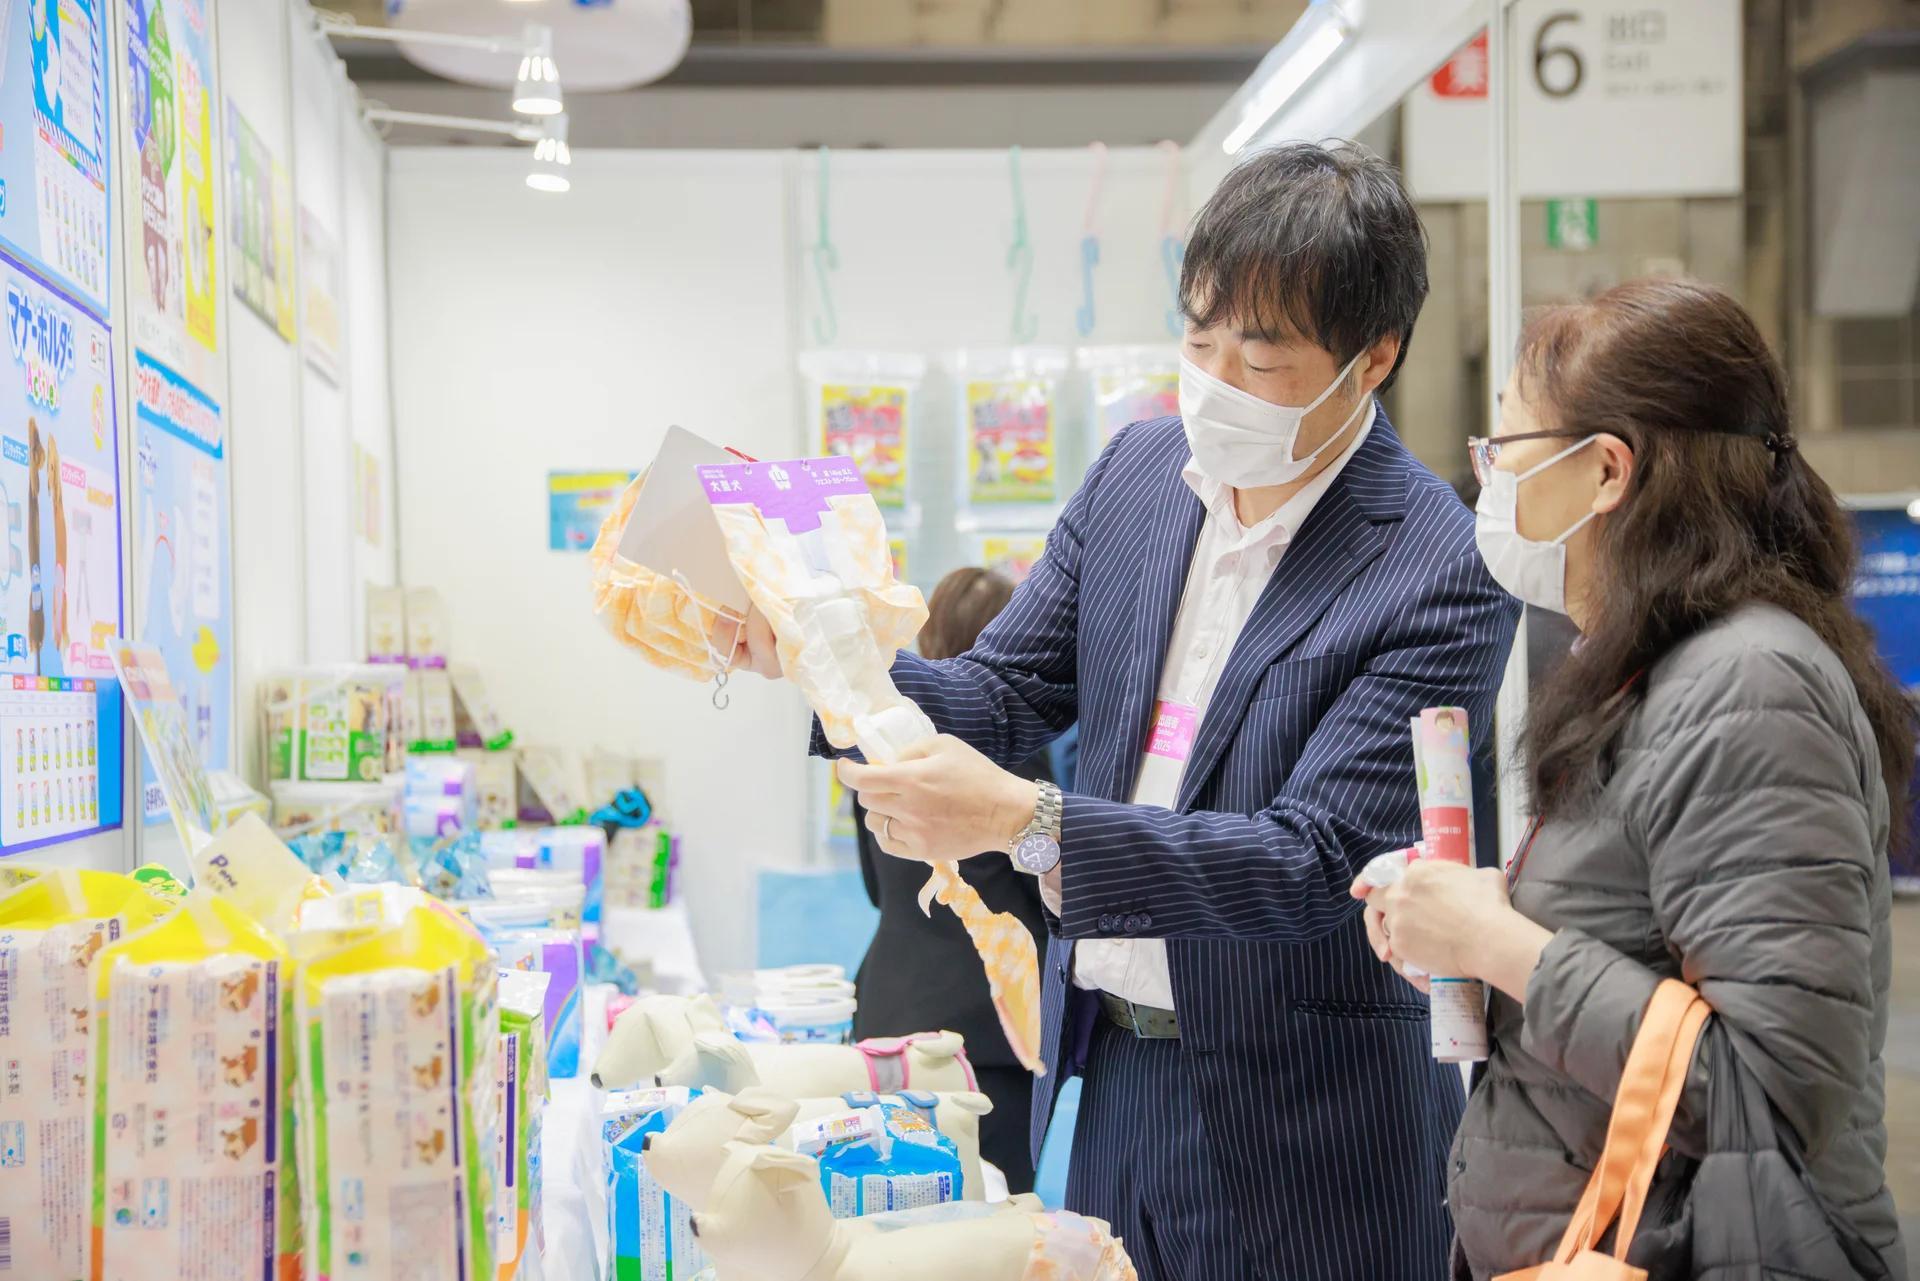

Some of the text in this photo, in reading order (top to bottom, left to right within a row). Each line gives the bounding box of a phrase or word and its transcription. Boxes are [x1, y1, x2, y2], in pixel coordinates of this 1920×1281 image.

[1533, 11, 1584, 98] 6
[8, 291, 73, 372] マナーホルダー
